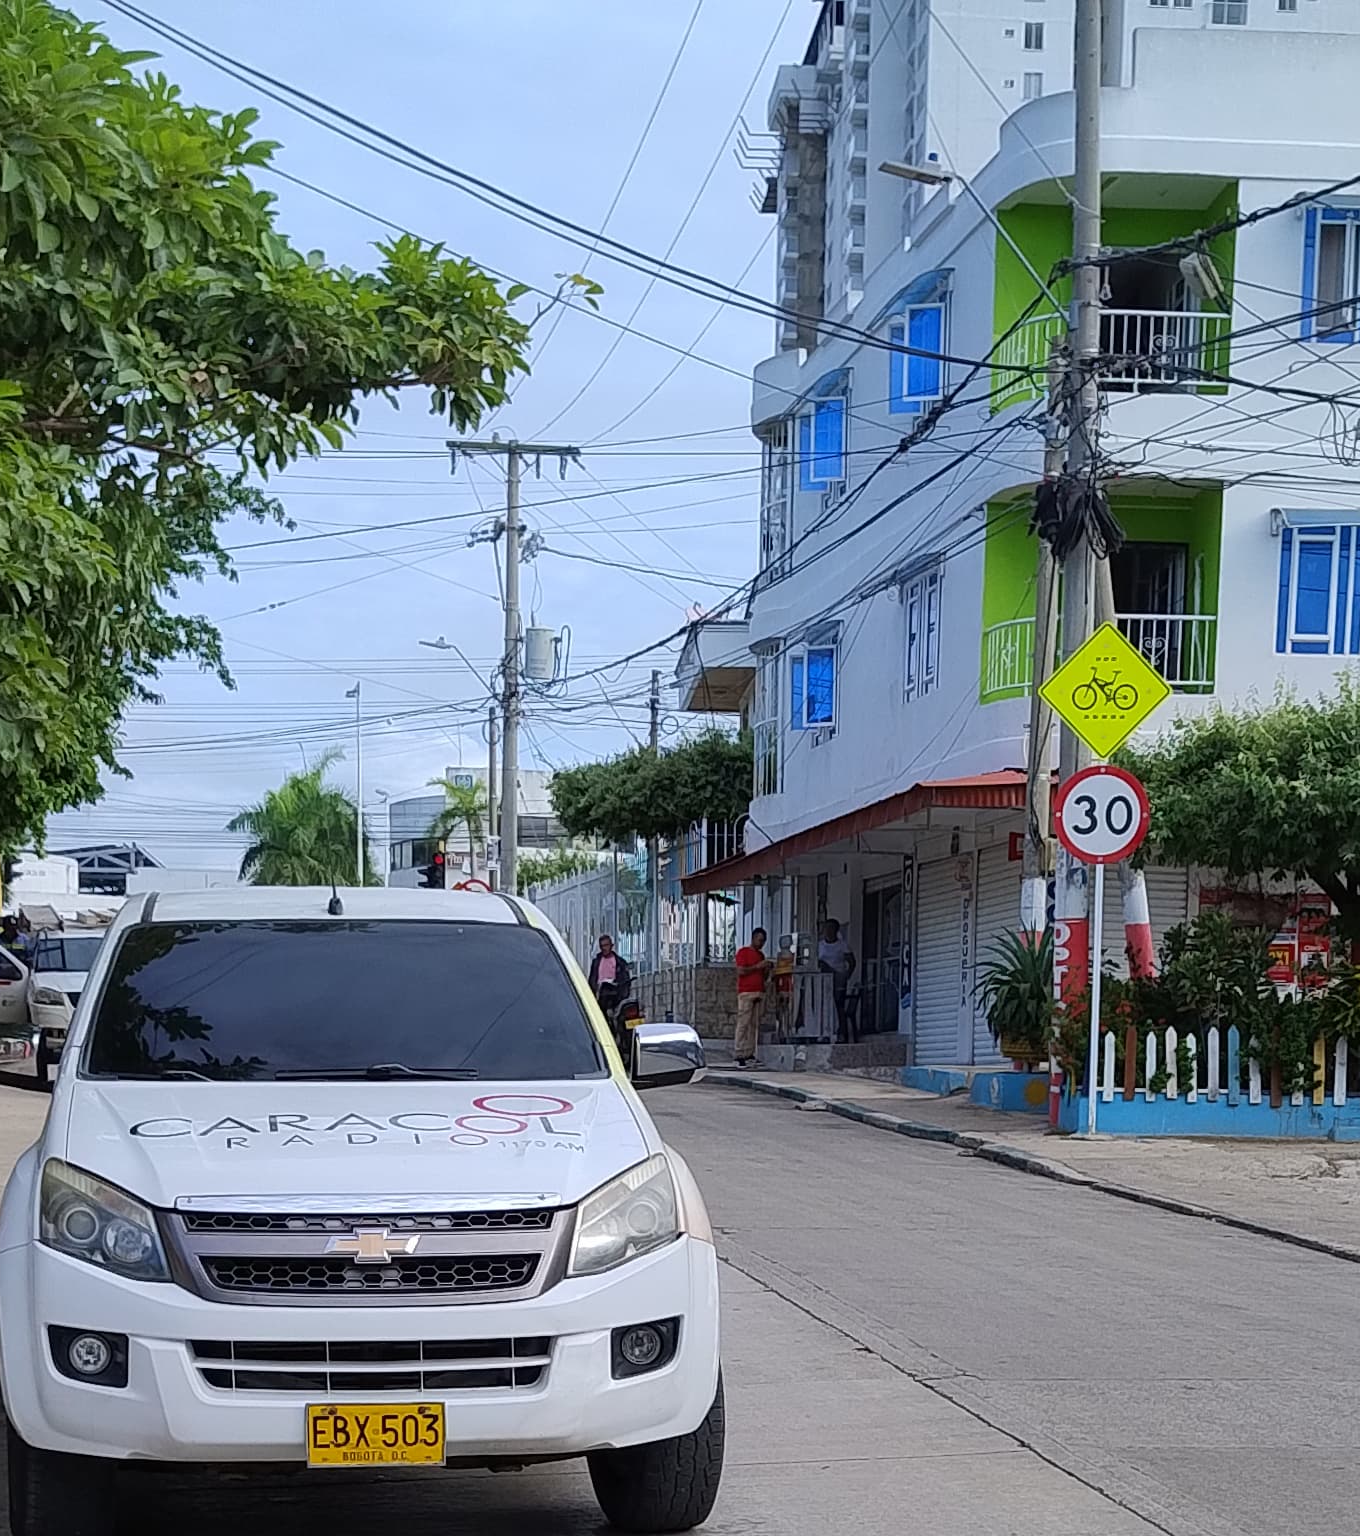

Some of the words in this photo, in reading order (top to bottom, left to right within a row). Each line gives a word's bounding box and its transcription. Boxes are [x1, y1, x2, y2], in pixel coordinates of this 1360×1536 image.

[1072, 795, 1133, 835] 30
[129, 1112, 581, 1138] CARACOL
[226, 1132, 489, 1149] RADIO
[553, 1142, 584, 1153] AM
[313, 1415, 370, 1448] EBX
[381, 1414, 439, 1447] 503
